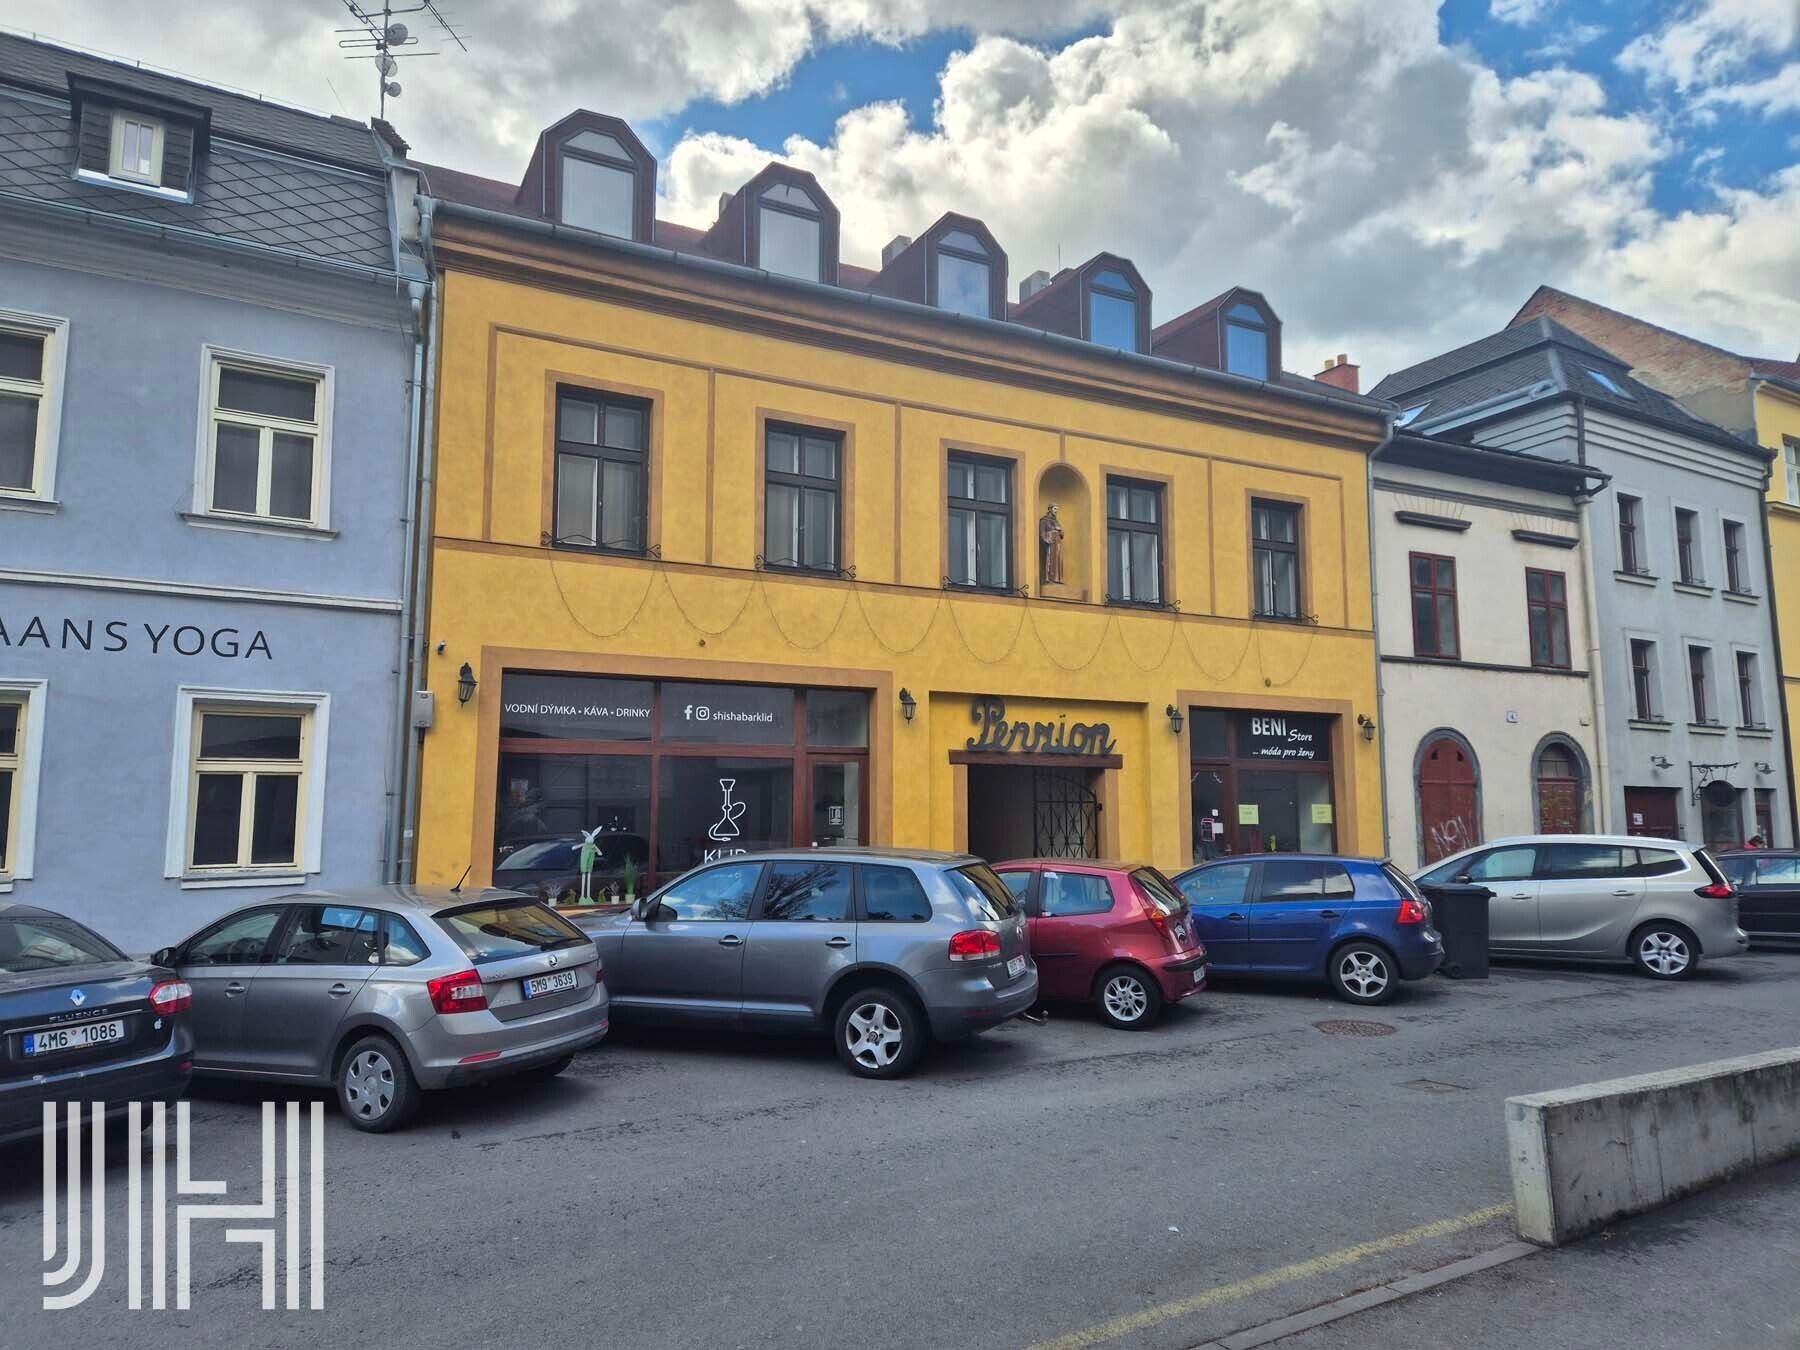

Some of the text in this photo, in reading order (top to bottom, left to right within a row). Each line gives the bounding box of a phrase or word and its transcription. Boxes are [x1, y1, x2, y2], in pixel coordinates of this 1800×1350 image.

[144, 623, 273, 660] YOGA
[504, 703, 651, 718] VODNÍ DÝMKA KÁVA DRINKY
[713, 711, 773, 722] shishabarklid
[966, 697, 1117, 754] Pension
[1252, 717, 1313, 742] BENI Store
[1260, 746, 1281, 756] móda
[1282, 749, 1296, 759] pro
[1297, 747, 1315, 759] ženy
[531, 972, 573, 993] 5M9 3639
[38, 1023, 117, 1050] 4M6 1086
